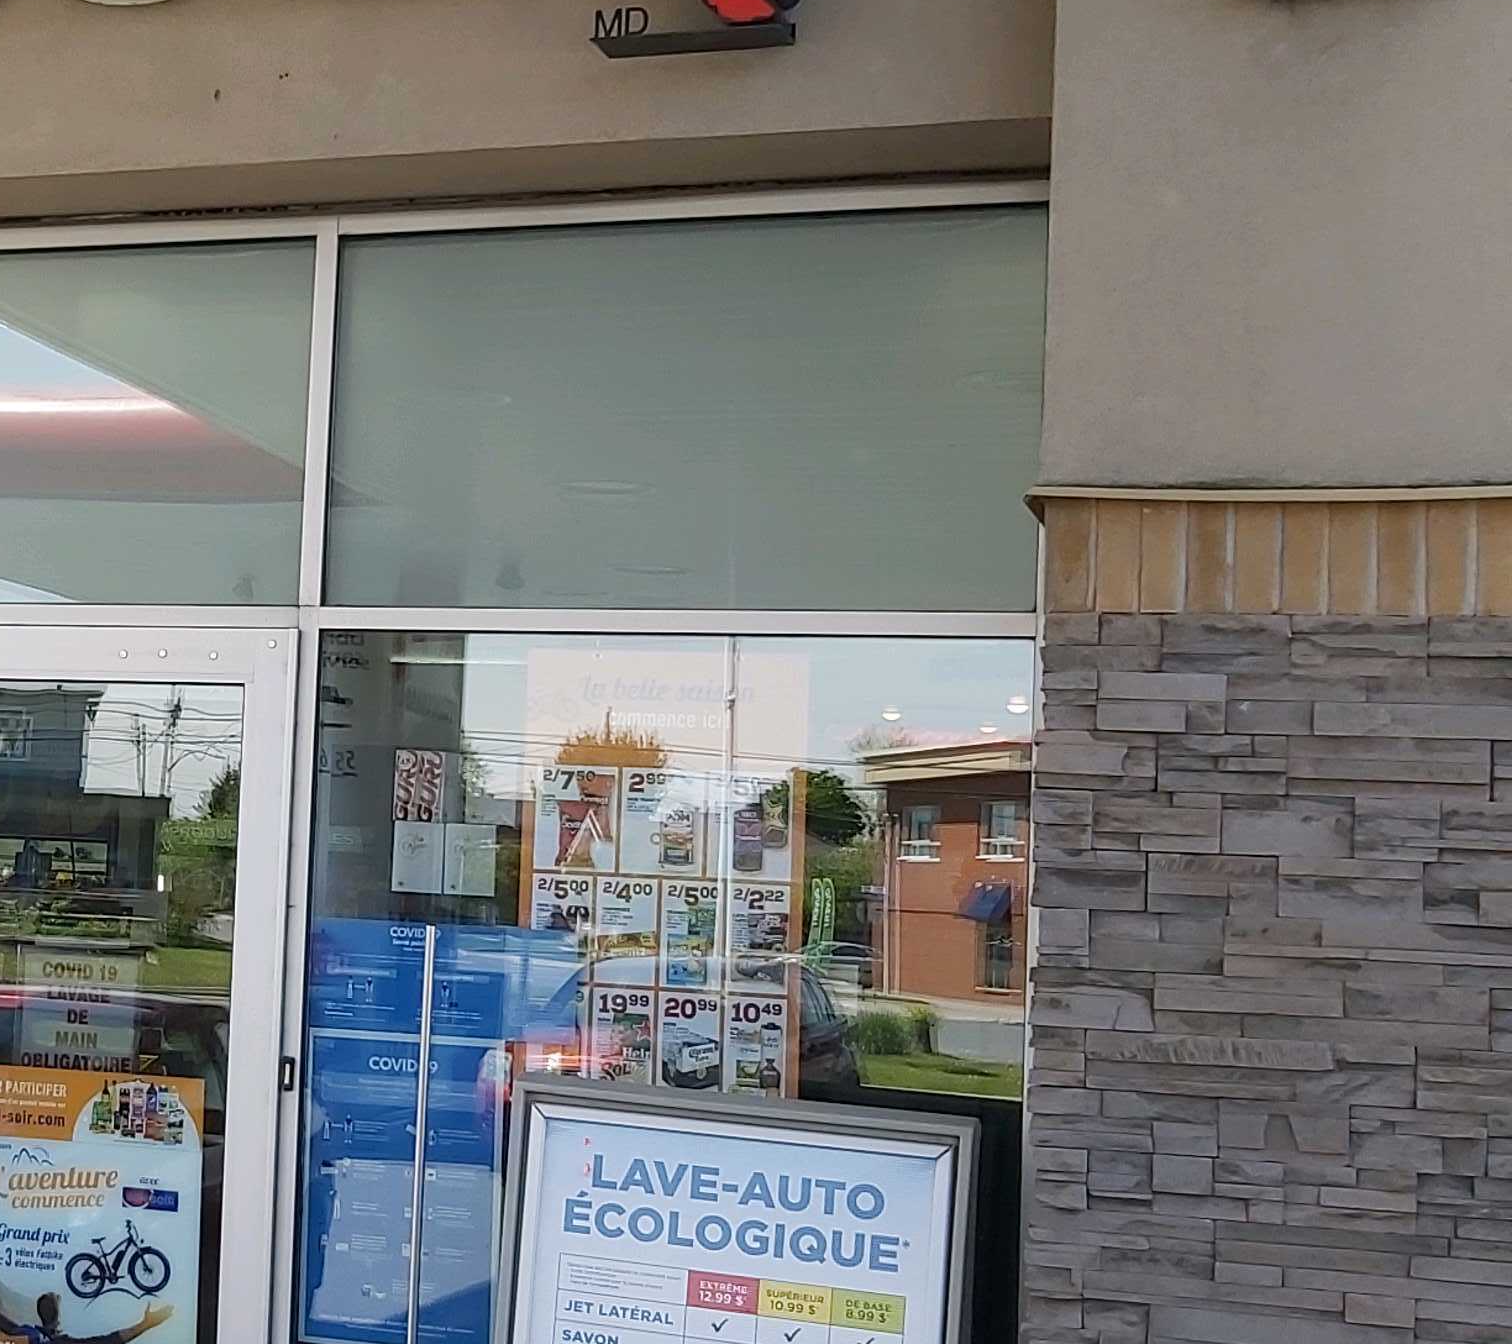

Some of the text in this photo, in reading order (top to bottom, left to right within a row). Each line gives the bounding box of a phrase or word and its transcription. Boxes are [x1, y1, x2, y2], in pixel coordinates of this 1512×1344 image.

[594, 7, 649, 38] MD
[42, 961, 117, 981] COVID 19
[46, 985, 111, 1004] LAVAGE
[67, 1009, 89, 1025] DE
[55, 1031, 98, 1049] MAIN
[21, 1052, 131, 1072] OBLIGATOIRE
[5, 1081, 67, 1097] PARTICIPER
[591, 1154, 885, 1220] LAVE-AUTO
[12, 1193, 105, 1209] commence
[42, 1227, 70, 1247] prix
[699, 1291, 732, 1305] 12.99
[770, 1300, 804, 1314] 10.99
[845, 1299, 859, 1308] DE
[564, 1299, 674, 1325] JET LATÉRAL
